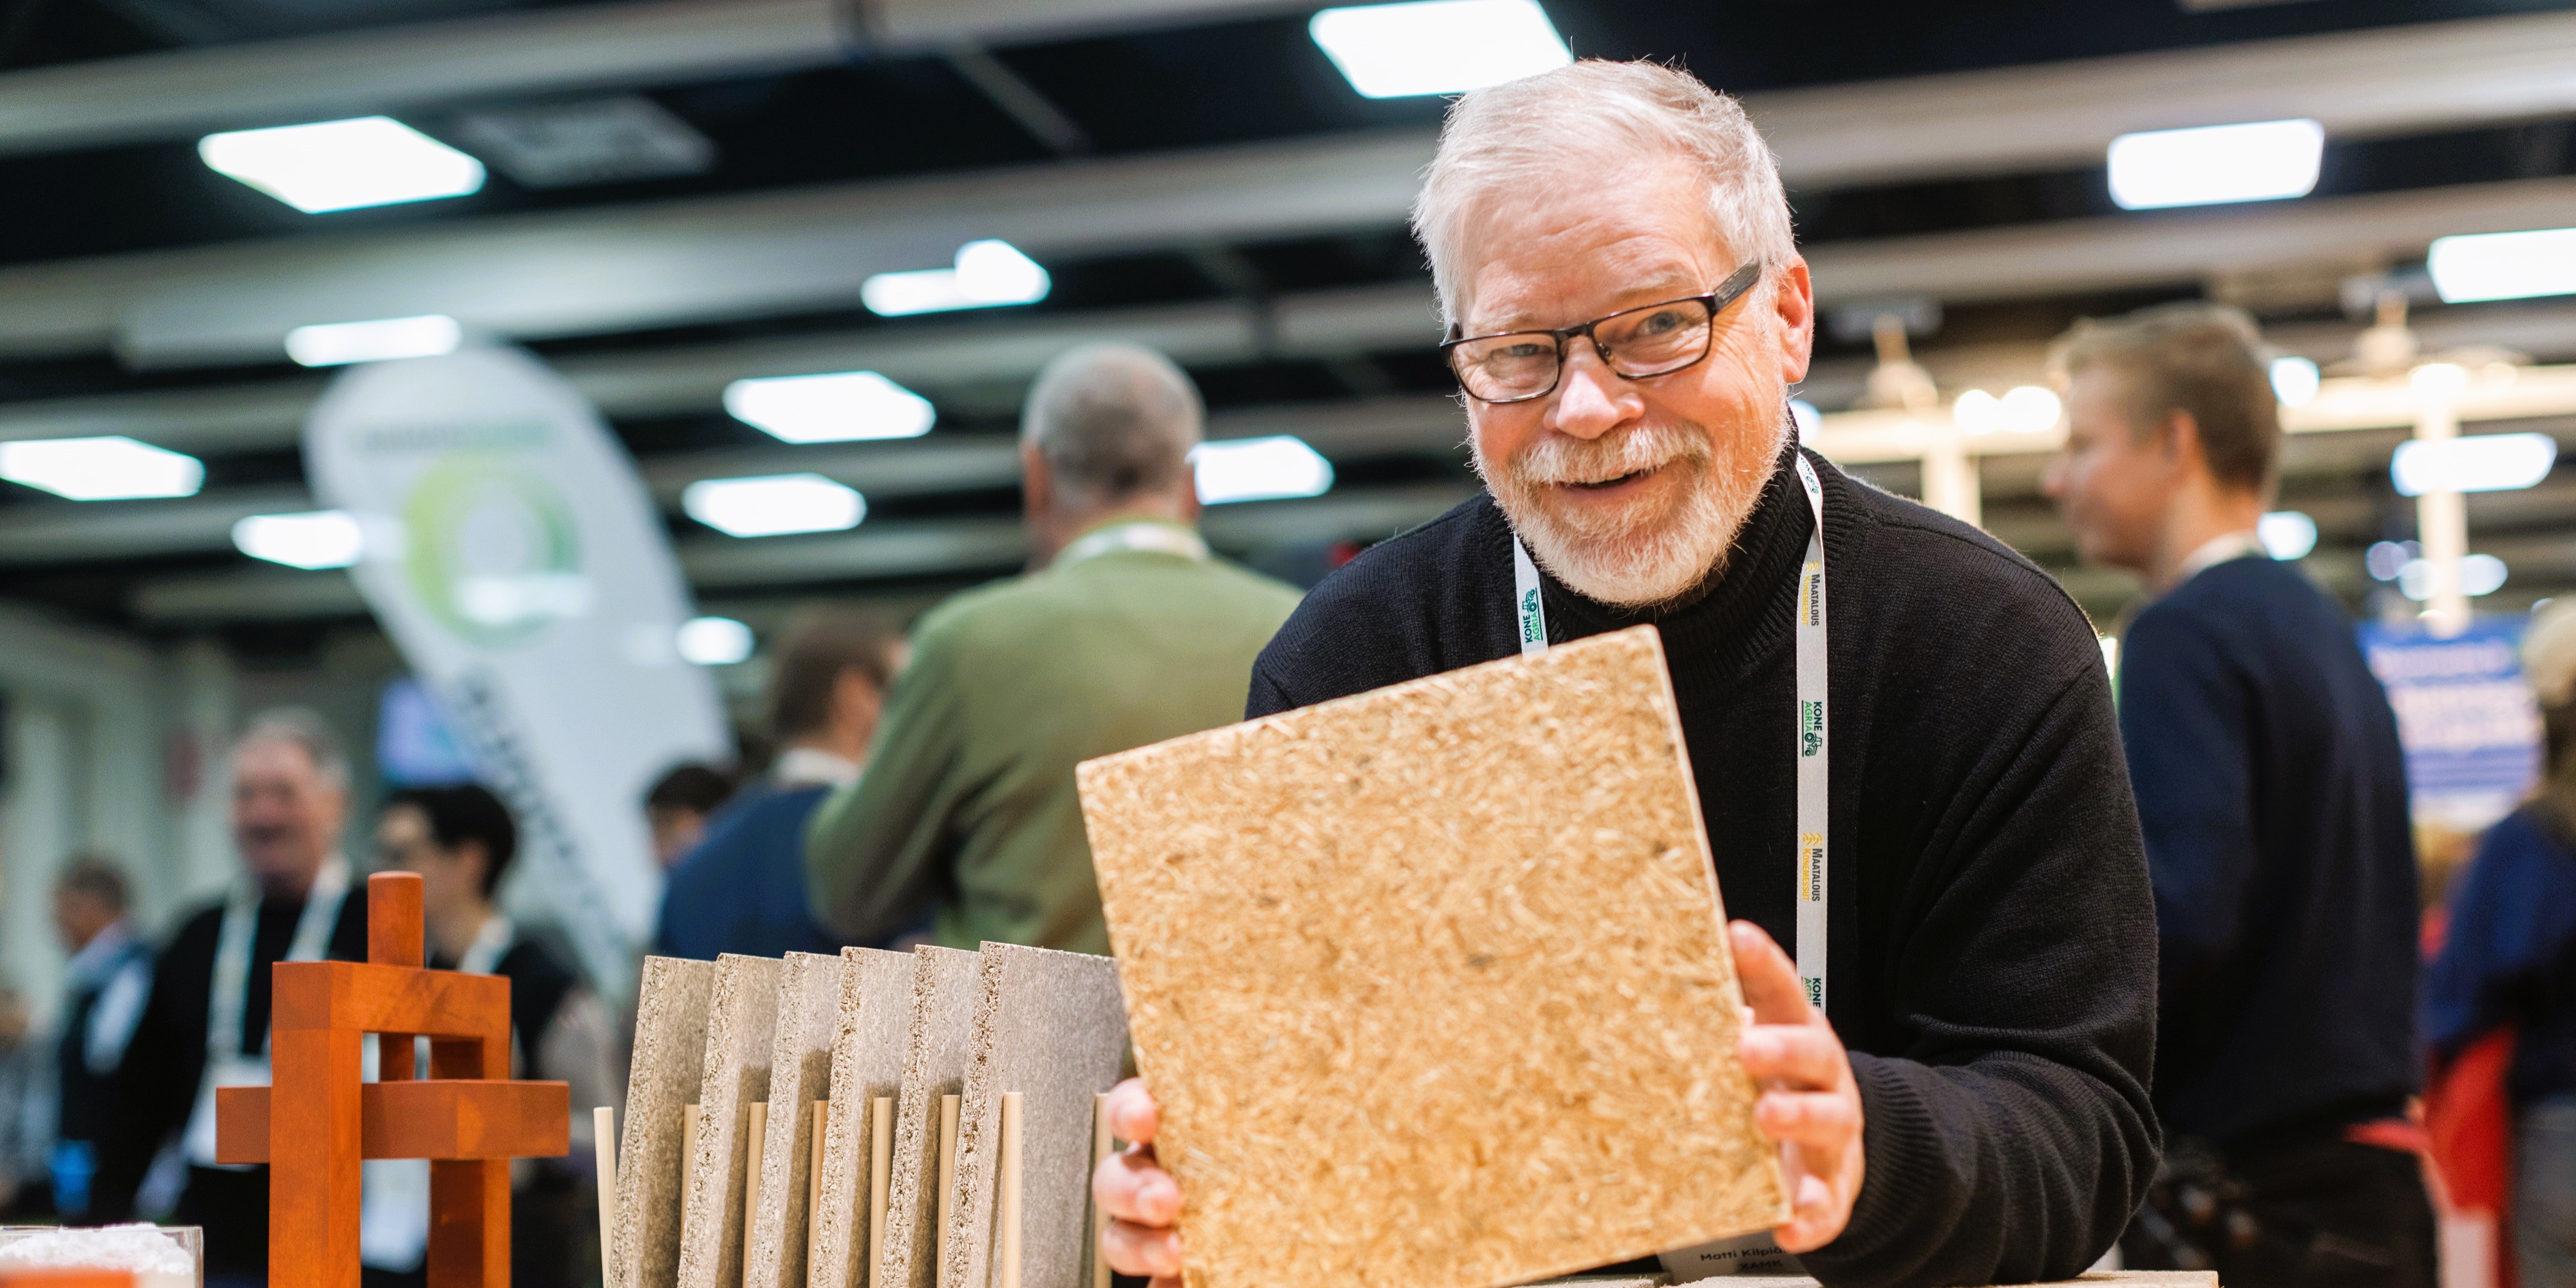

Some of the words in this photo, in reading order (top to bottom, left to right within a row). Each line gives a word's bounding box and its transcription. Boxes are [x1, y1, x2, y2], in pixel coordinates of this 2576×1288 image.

[1802, 576, 1810, 626] KONEMESSUT
[1811, 574, 1820, 626] MAATALOUS
[1523, 614, 1533, 643] KONE
[1531, 611, 1540, 640] AGRIA
[1814, 701, 1822, 731] KONE
[1803, 848, 1811, 901] KONEMESSUT
[1812, 848, 1823, 901] MAATALOUS
[1812, 978, 1821, 1007] KONE
[1700, 1249, 1738, 1261] Matti
